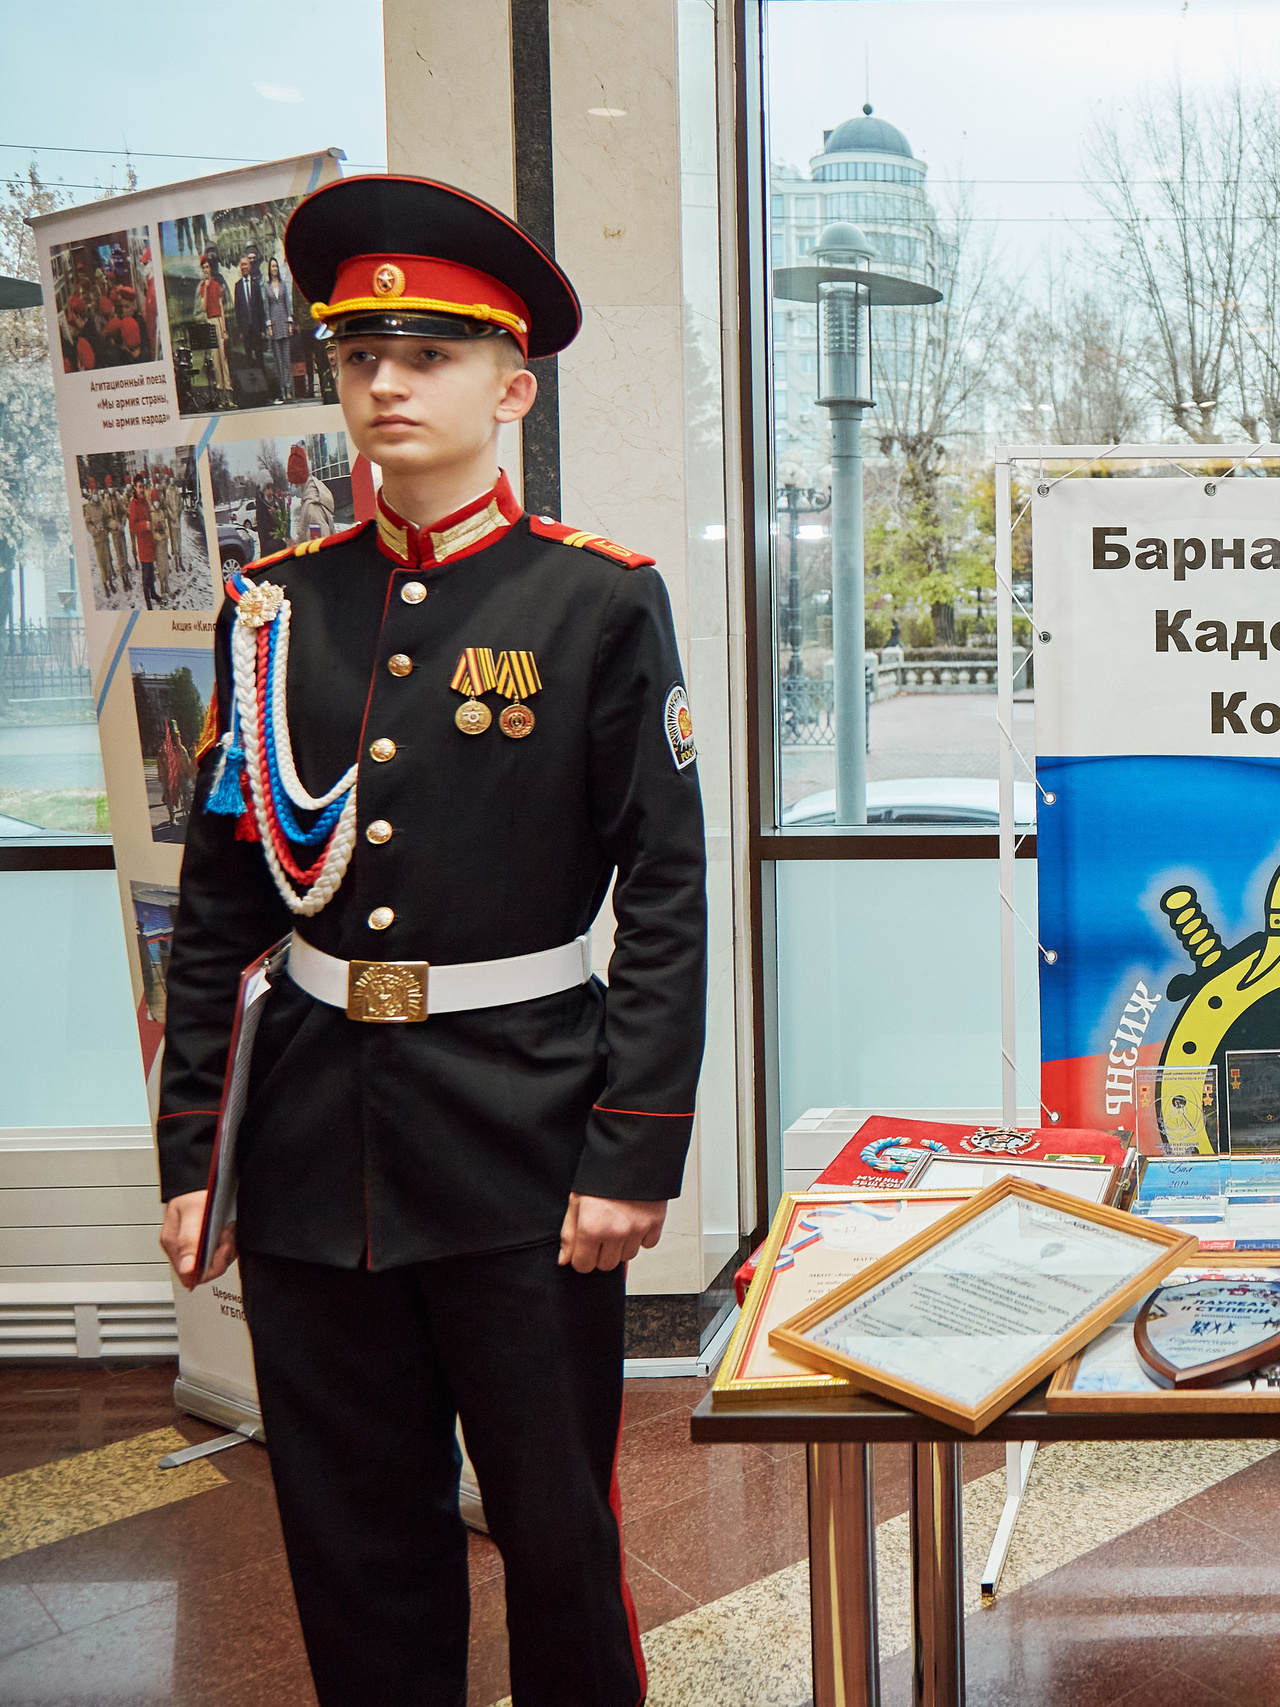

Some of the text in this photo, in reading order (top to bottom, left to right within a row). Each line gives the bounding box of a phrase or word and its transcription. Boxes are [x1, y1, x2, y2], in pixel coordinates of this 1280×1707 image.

[90, 374, 167, 392] Агитационный поезд
[97, 394, 169, 410] «Мы армия страны,
[102, 413, 171, 429] мы армия народа»
[594, 539, 634, 558] Б
[171, 620, 192, 632] Акция
[1193, 1299, 1267, 1307] ЛАУРЕАТ
[1195, 1306, 1271, 1314] СТЕПЕНИ
